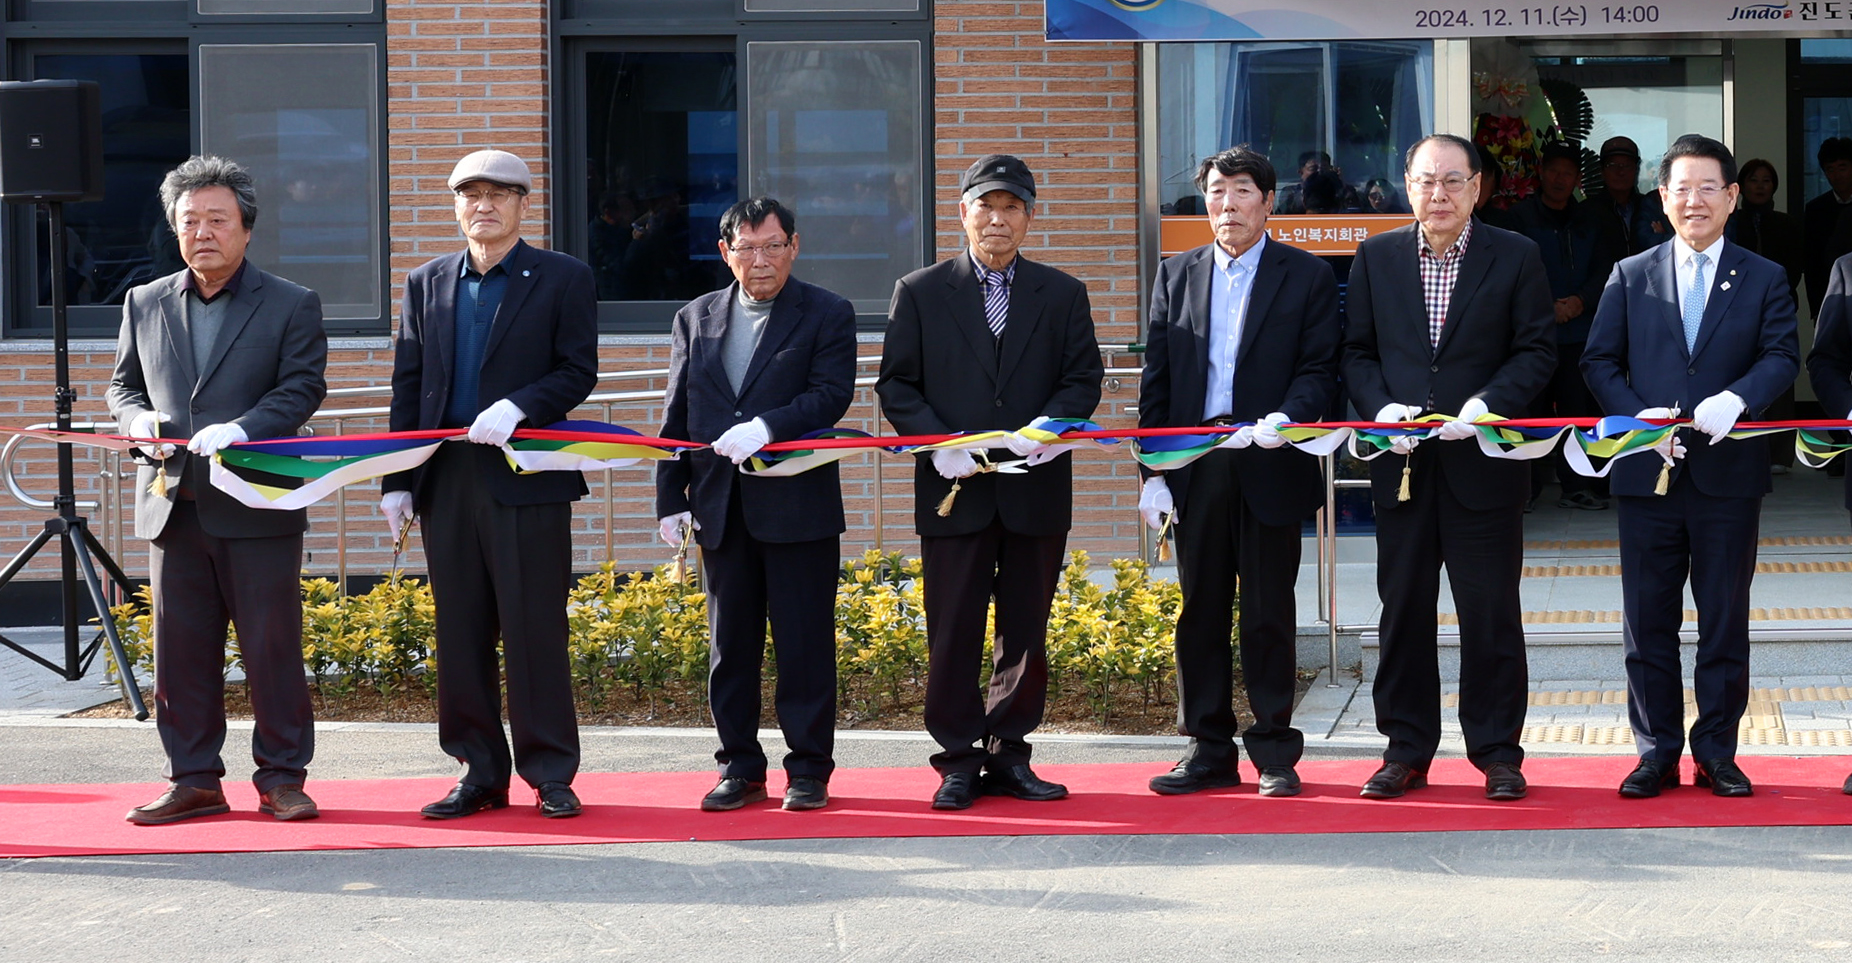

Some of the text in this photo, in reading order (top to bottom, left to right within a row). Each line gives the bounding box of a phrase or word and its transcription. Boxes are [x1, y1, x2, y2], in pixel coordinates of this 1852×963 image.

[1415, 6, 1660, 28] 2024. 12. 11.(수) 14:00
[1726, 0, 1790, 22] Jindo
[1277, 227, 1369, 243] 노인복지회관
